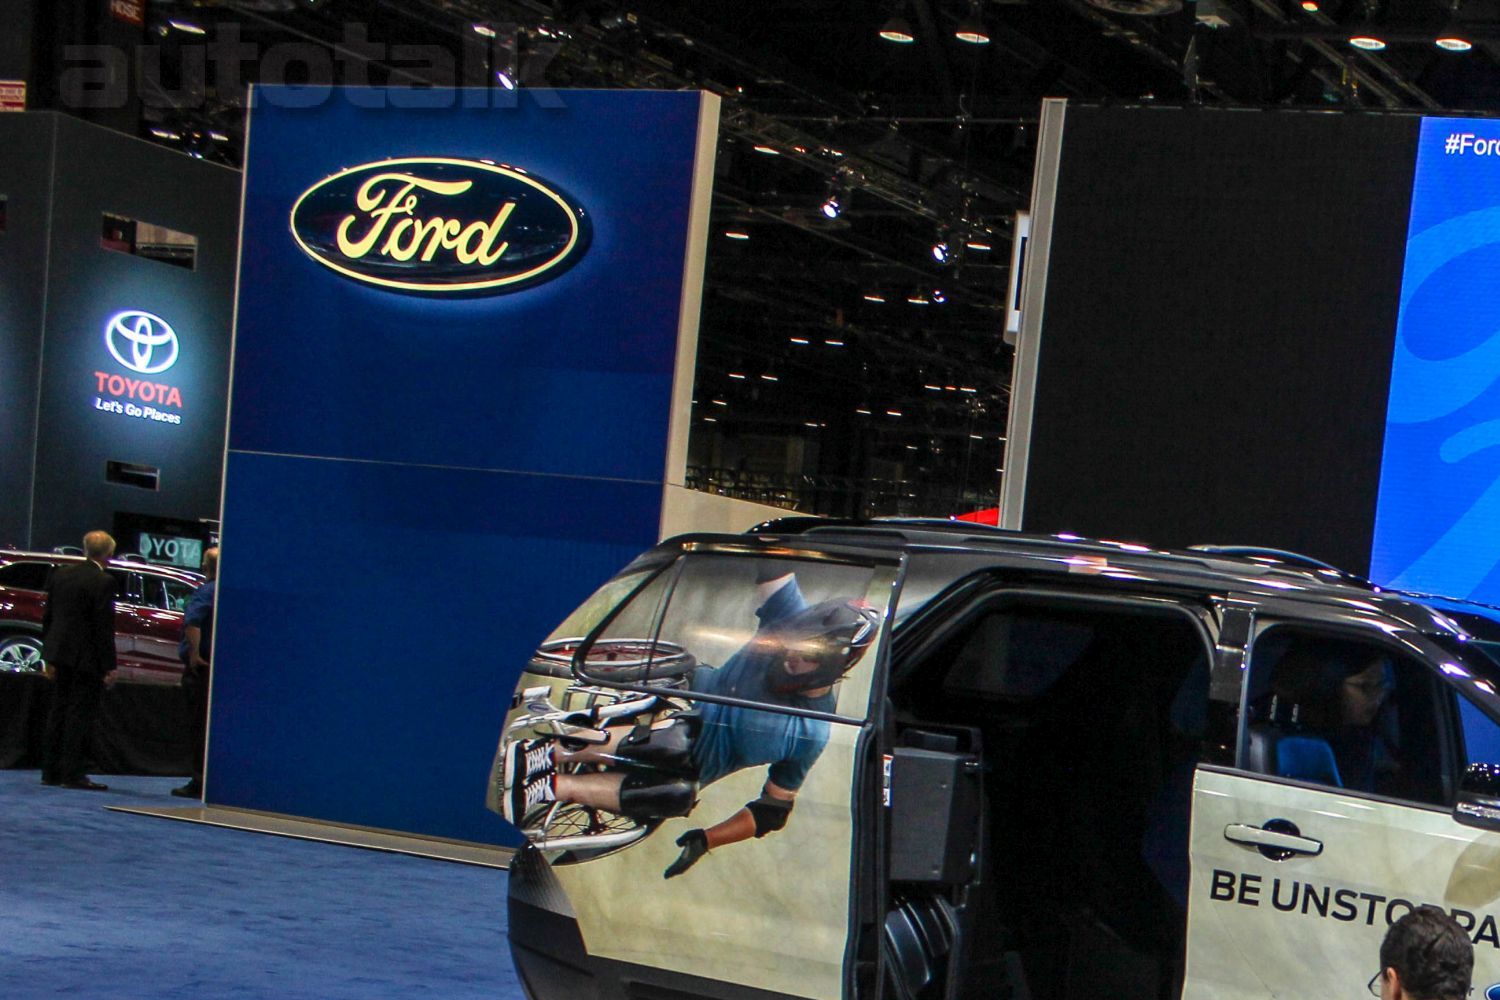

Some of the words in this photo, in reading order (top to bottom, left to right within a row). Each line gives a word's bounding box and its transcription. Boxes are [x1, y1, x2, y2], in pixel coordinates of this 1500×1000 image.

[336, 172, 516, 267] Ford
[94, 371, 183, 408] TOYOTA
[95, 397, 123, 414] Let's
[125, 403, 142, 417] Go
[143, 406, 181, 424] Places
[1209, 868, 1263, 907] BE
